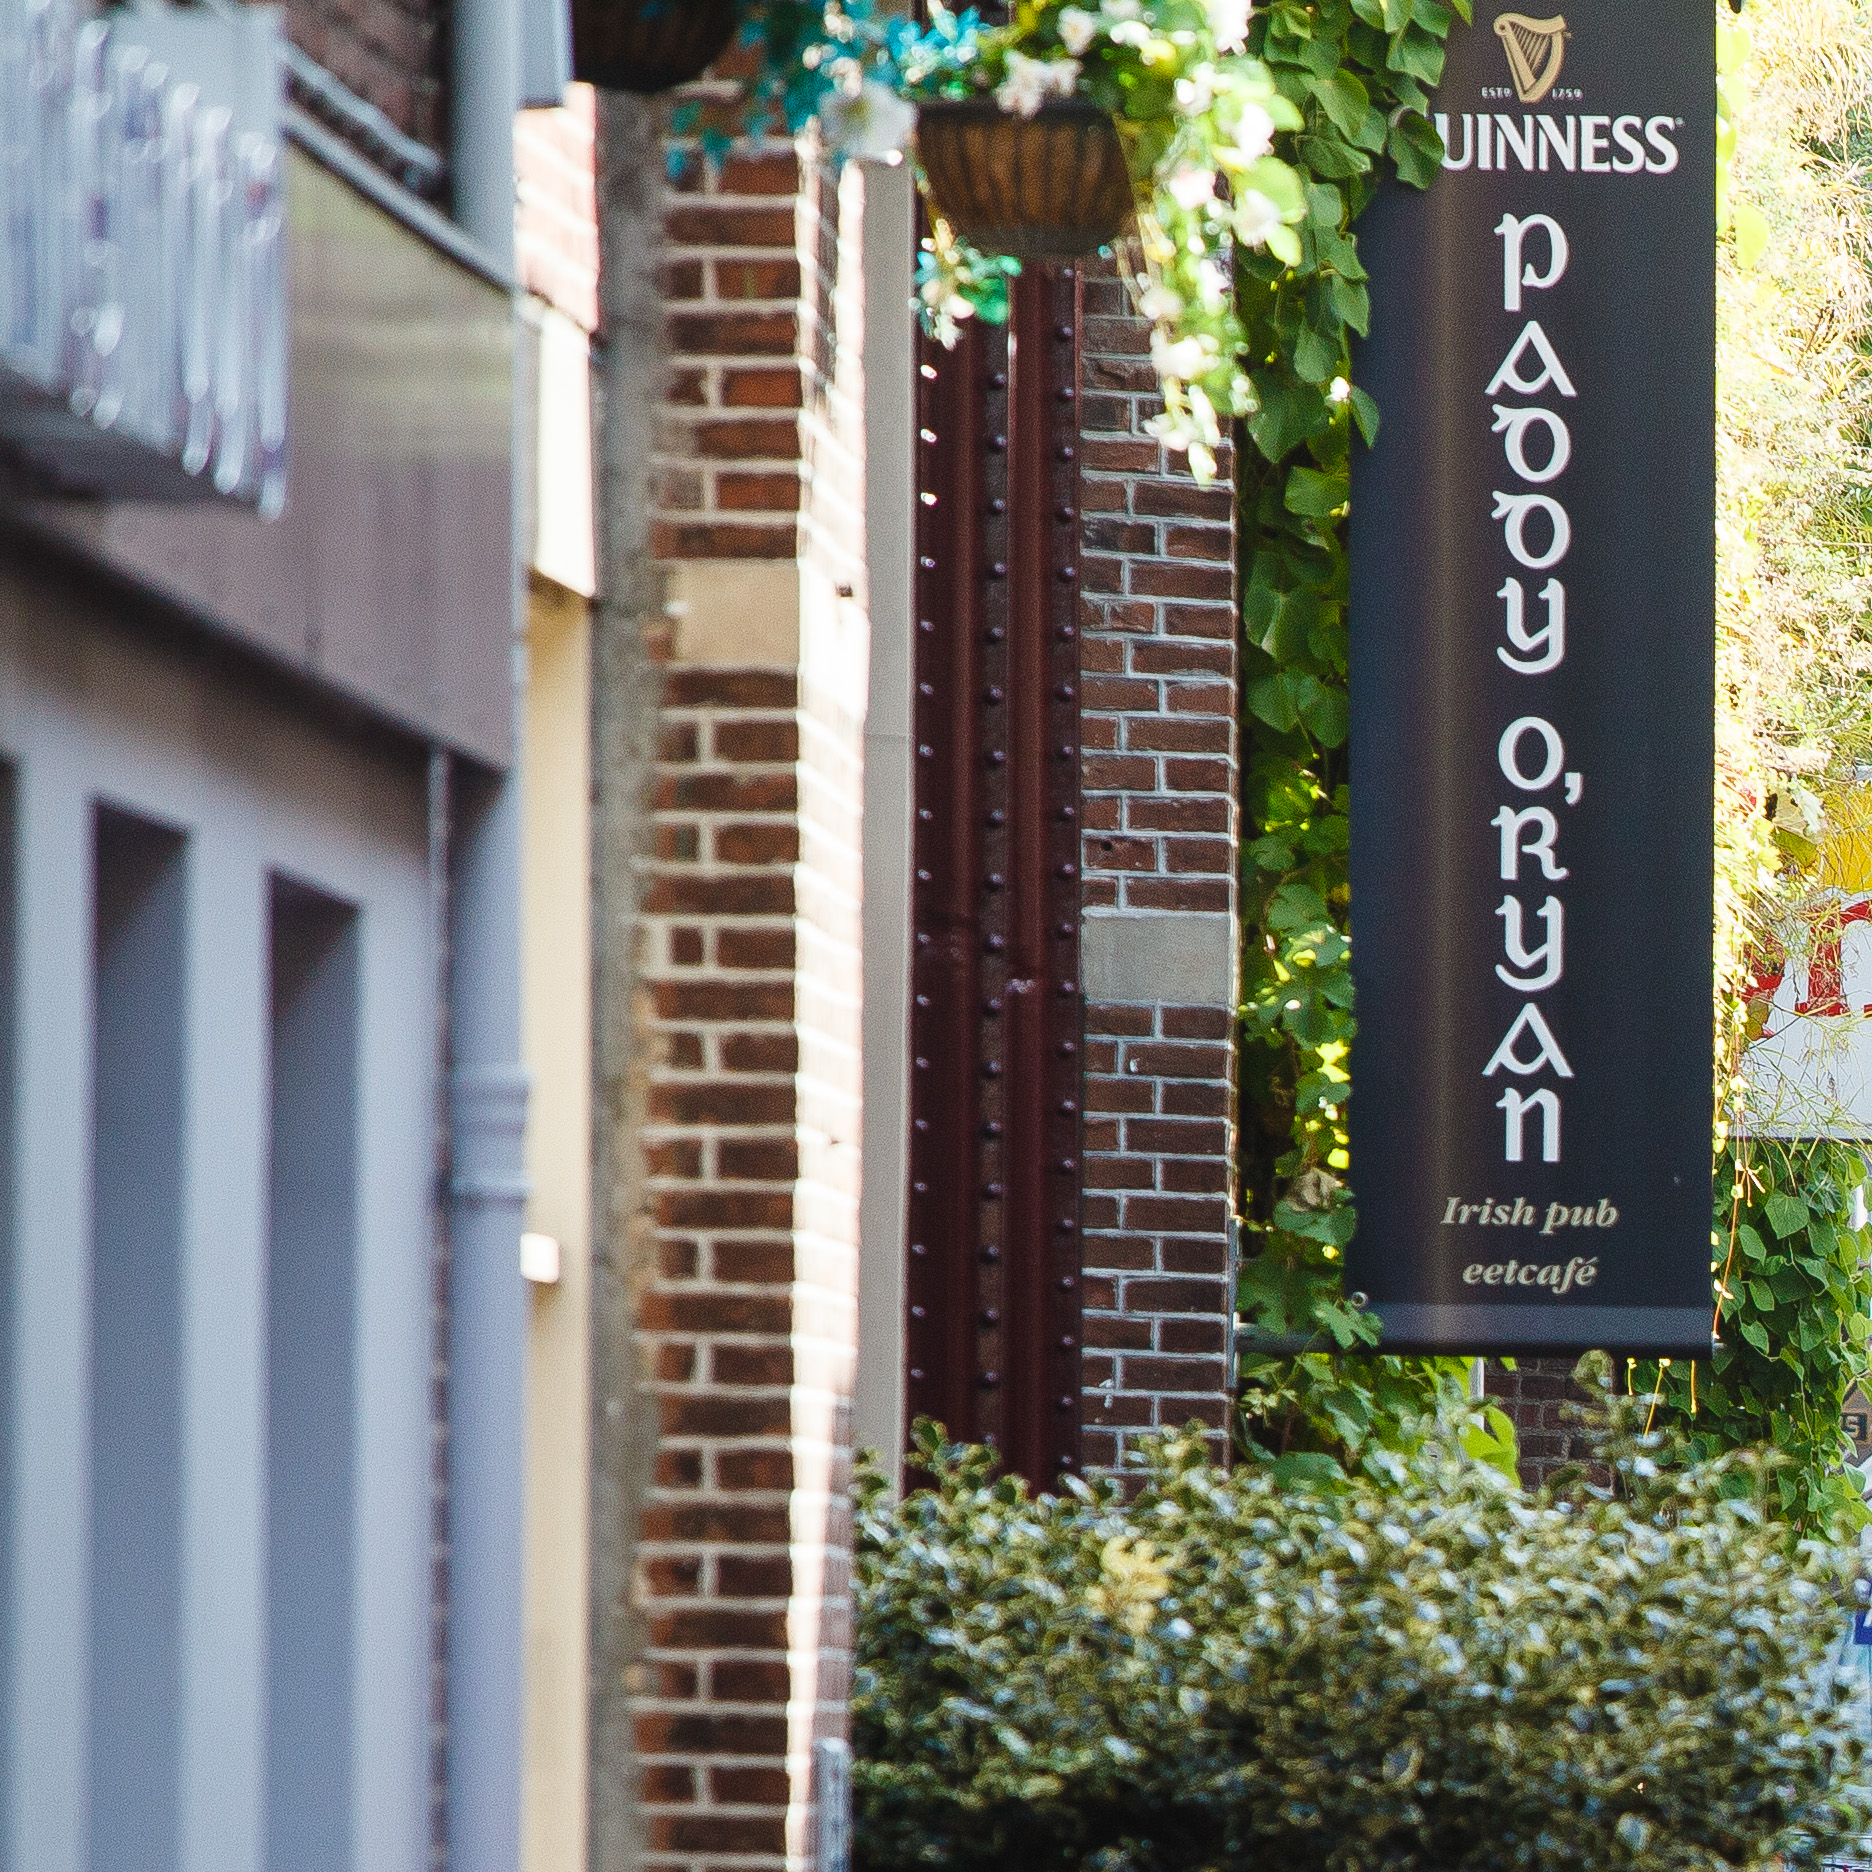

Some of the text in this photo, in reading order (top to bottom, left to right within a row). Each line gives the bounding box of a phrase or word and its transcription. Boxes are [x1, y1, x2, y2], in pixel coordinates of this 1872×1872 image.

[1433, 112, 1680, 175] UINNESS
[1440, 1196, 1620, 1236] Irish pub
[1462, 1256, 1600, 1295] eetcafé
